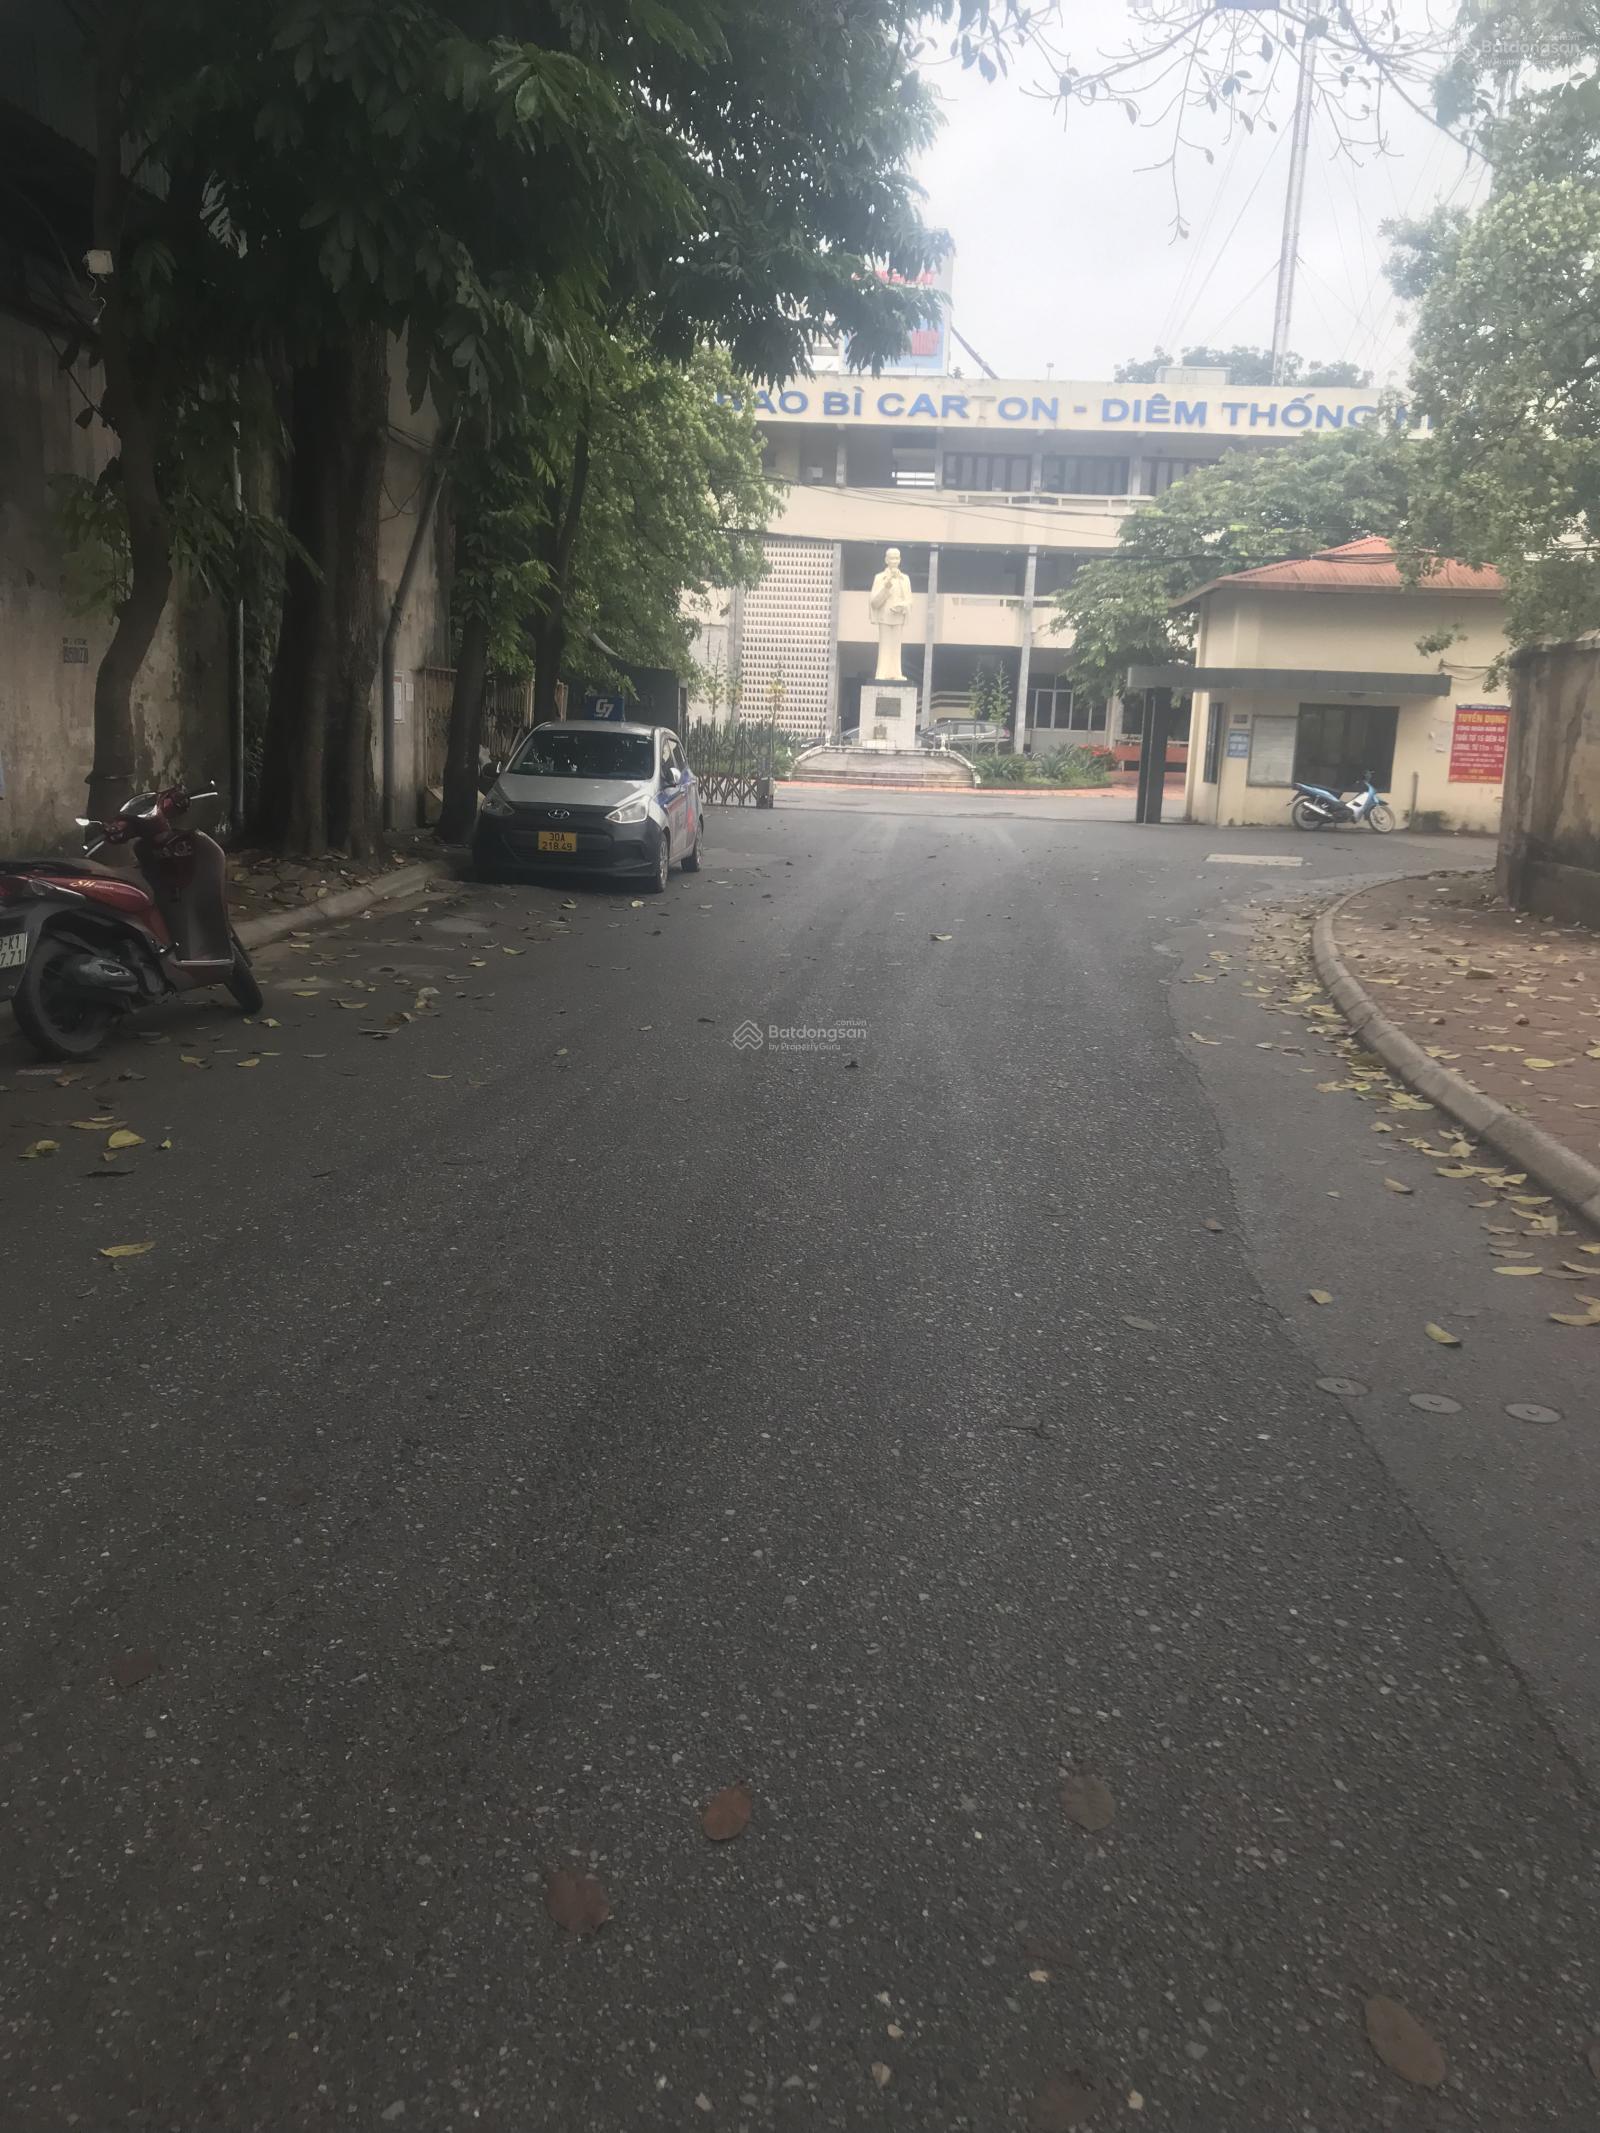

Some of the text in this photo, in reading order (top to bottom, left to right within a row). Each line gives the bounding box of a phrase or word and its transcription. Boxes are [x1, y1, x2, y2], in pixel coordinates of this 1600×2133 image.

[823, 386, 865, 417] BÌ
[1102, 393, 1208, 428] DIÊM
[549, 832, 566, 842] 30A
[542, 841, 573, 852] 218.49
